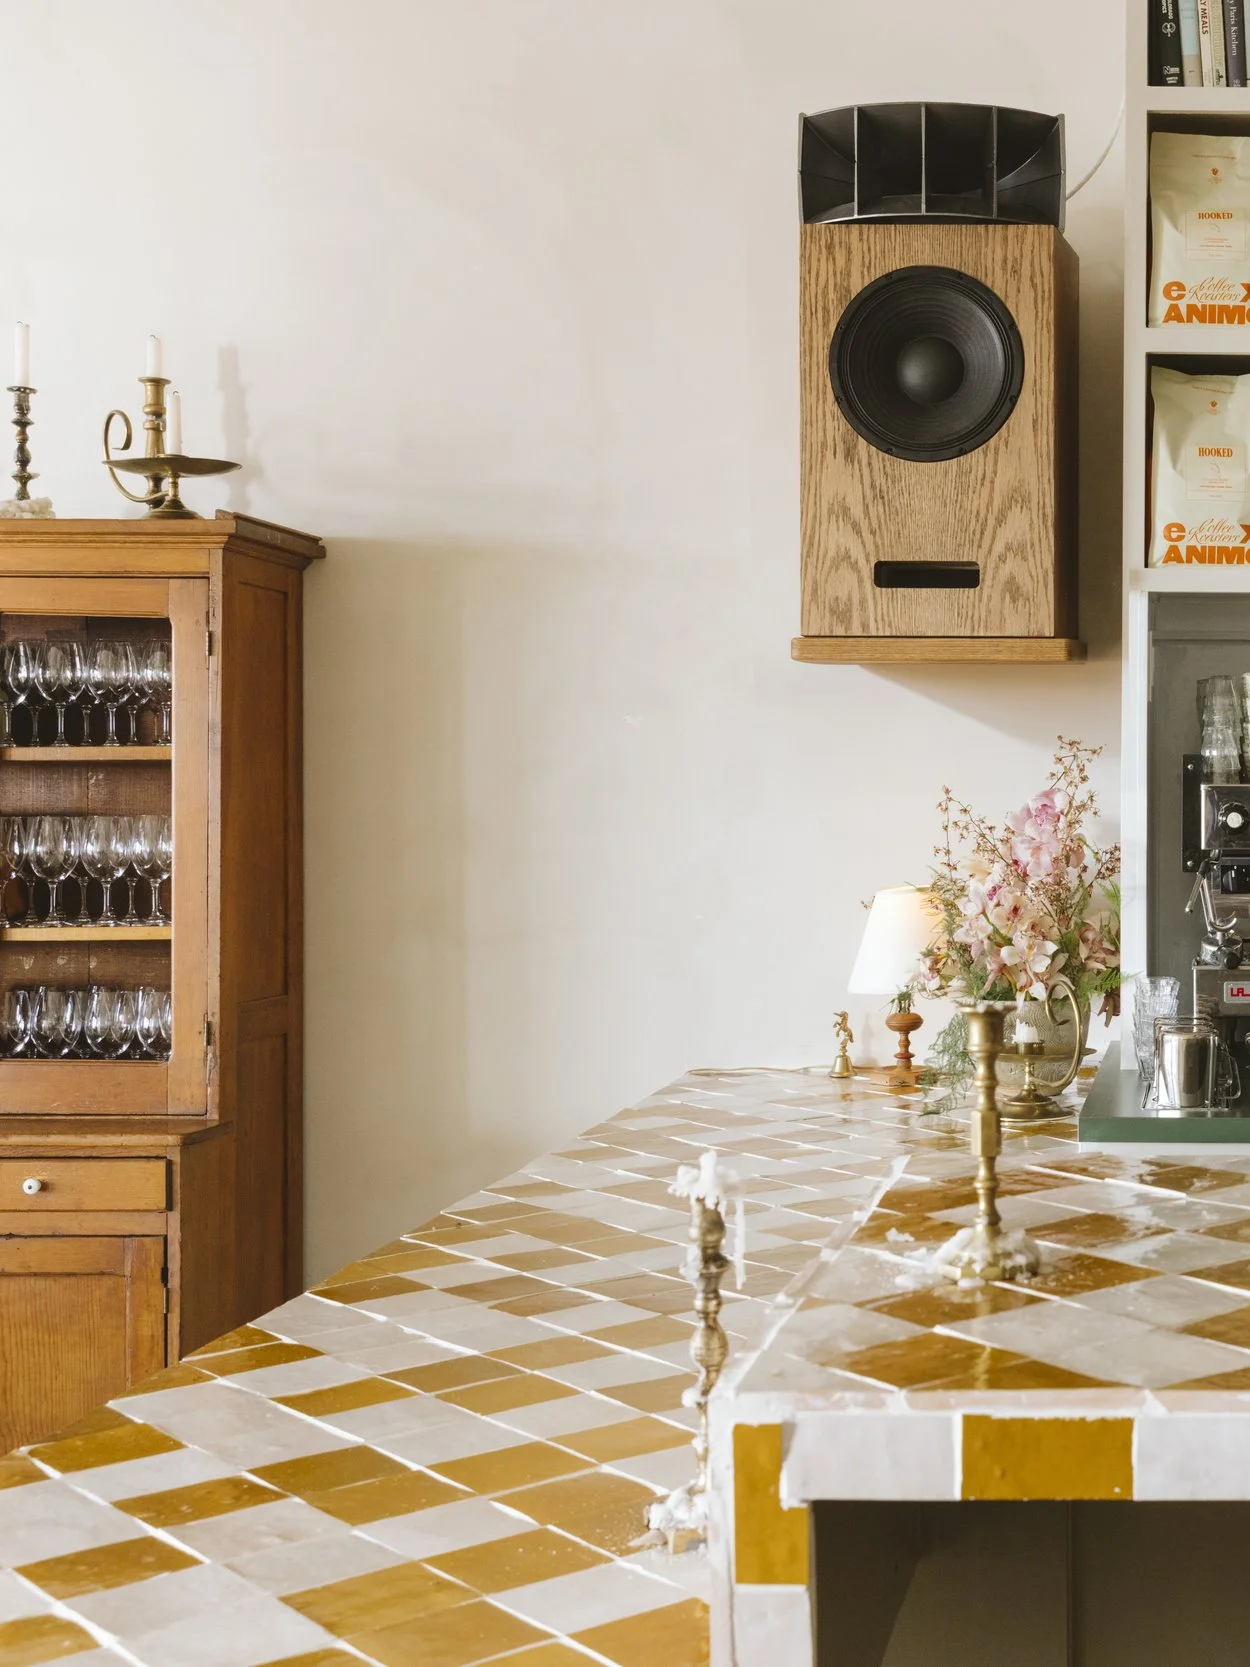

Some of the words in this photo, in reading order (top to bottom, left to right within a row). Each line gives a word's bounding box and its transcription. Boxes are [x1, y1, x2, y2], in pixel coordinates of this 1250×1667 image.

[1231, 27, 1239, 56] Kitchen
[1198, 212, 1233, 220] HOOKED
[1198, 447, 1233, 458] HOOKED
